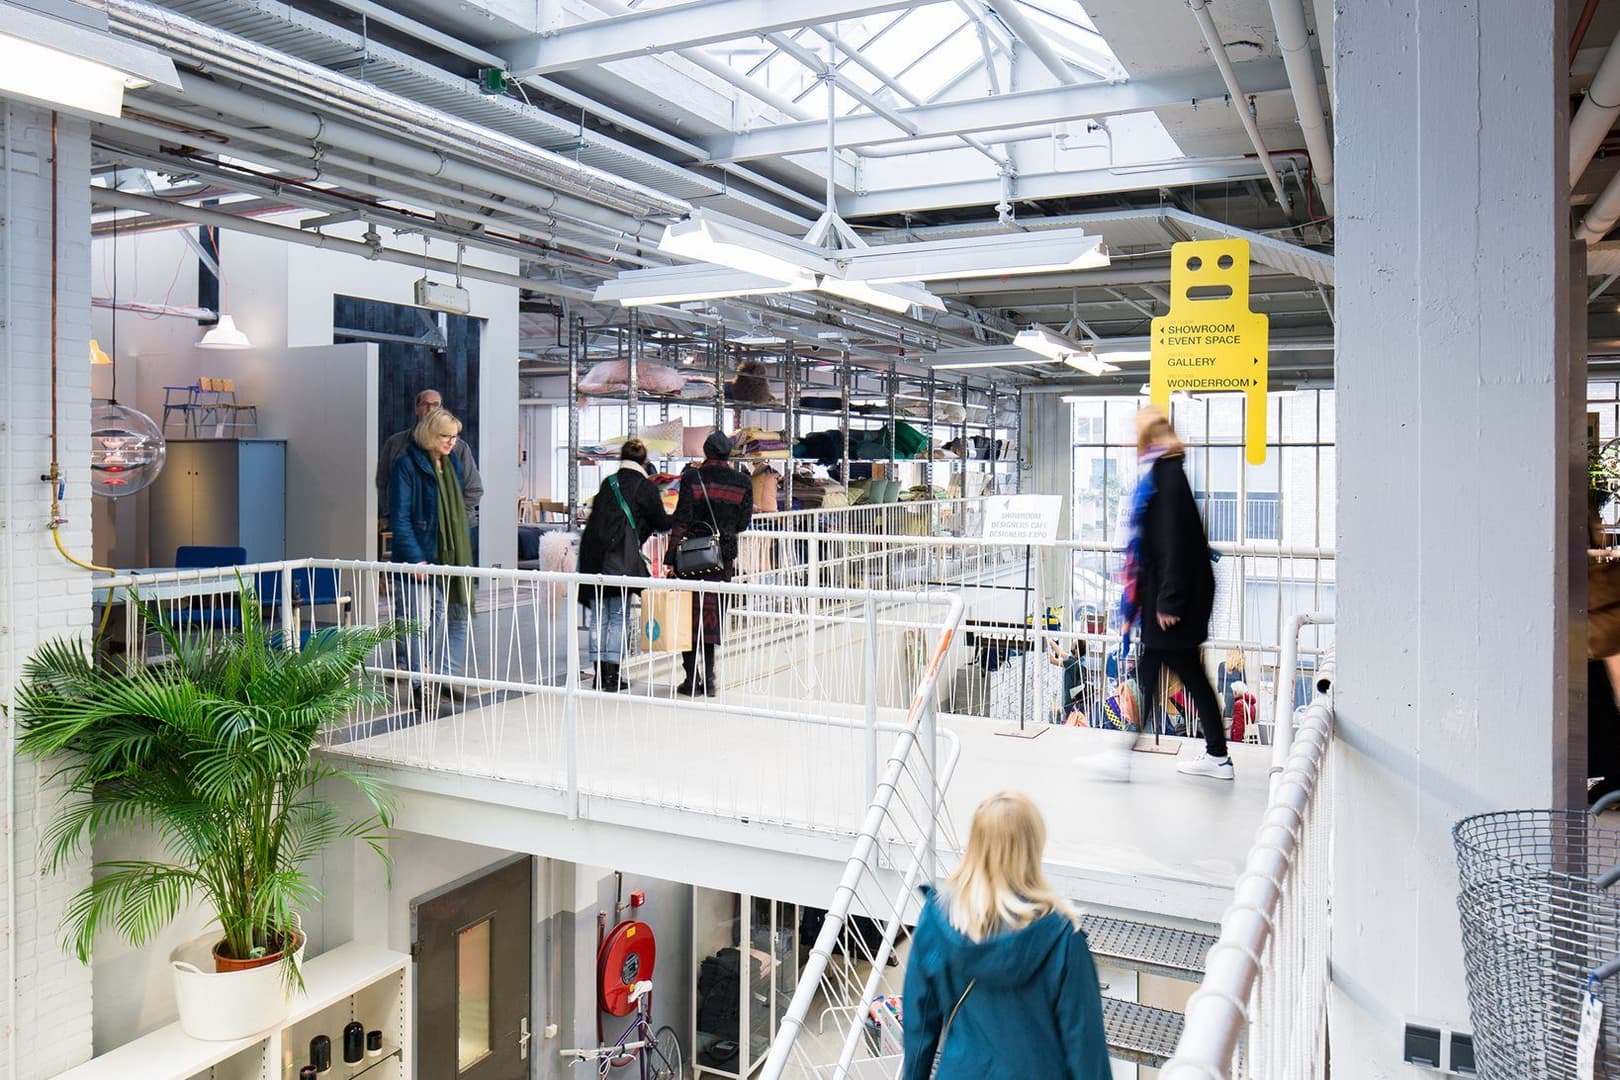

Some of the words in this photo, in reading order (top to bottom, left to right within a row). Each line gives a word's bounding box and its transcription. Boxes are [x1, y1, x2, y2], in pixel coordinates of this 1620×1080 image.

[1168, 324, 1235, 334] SHOWROOM
[1168, 336, 1202, 345] EVENT
[1205, 335, 1241, 344] SPACE
[1167, 357, 1216, 367] GALLERY
[1167, 379, 1249, 388] WONDERROOM
